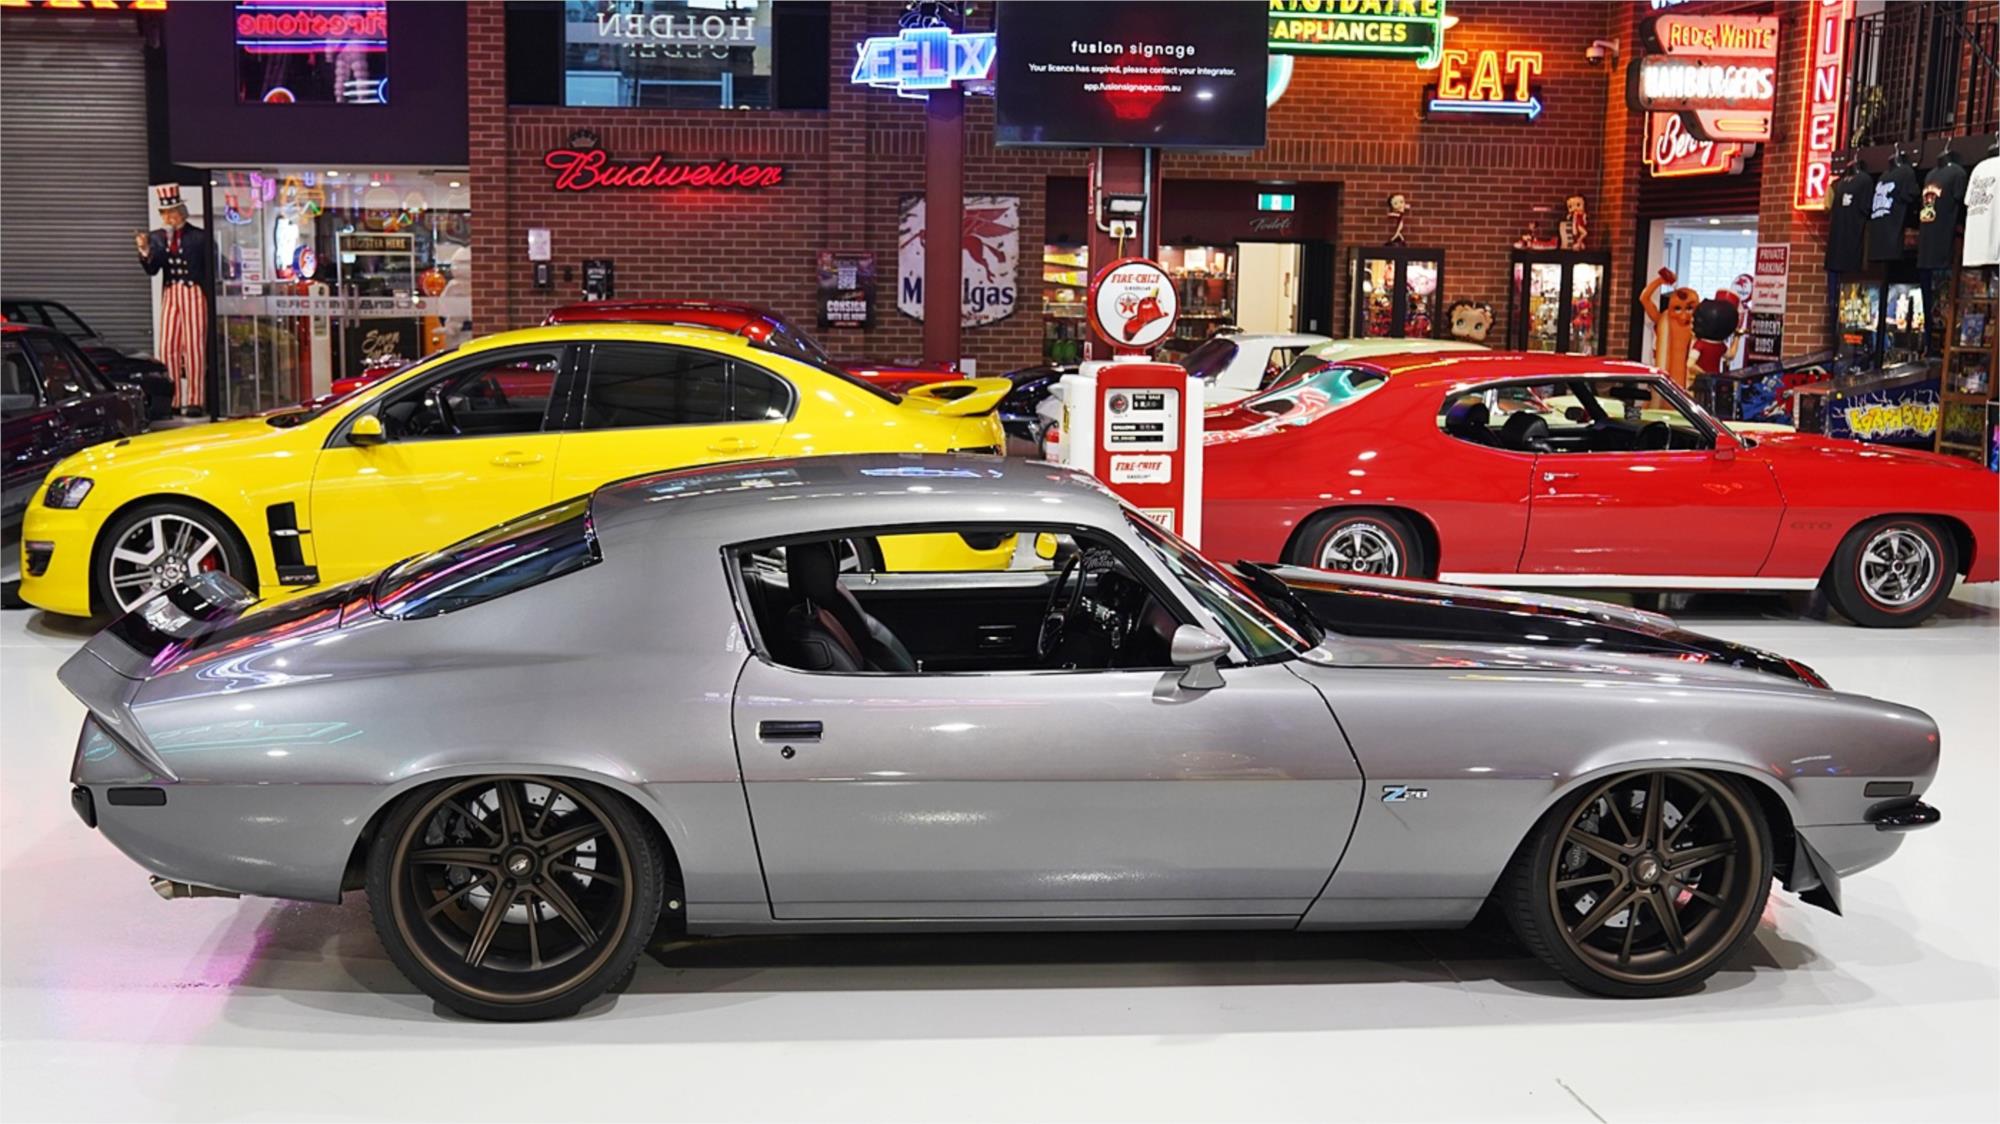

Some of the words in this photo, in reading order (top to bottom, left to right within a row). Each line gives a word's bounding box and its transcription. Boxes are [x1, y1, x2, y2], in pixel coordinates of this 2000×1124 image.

[1274, 20, 1407, 42] APPLIANCES
[1669, 23, 1701, 46] RED
[1716, 23, 1774, 49] WHITE
[869, 39, 985, 77] FELIX
[1071, 40, 1124, 54] fusion
[1129, 42, 1196, 58] signage
[1028, 63, 1047, 72] Your
[1048, 63, 1075, 73] licence
[1076, 64, 1090, 73] has
[1091, 65, 1121, 75] expired,
[1122, 66, 1148, 75] please
[1149, 67, 1178, 75] contact
[1178, 68, 1197, 76] your
[1197, 66, 1236, 76] integrator.
[1438, 49, 1543, 101] EAT
[1083, 83, 1181, 92] app.fusionsignage.com.au
[1644, 65, 1774, 100] HAMBURGERS
[1805, 0, 1837, 198] INER
[545, 150, 783, 190] Budweiser
[1759, 247, 1785, 260] PRIVATE
[1757, 261, 1784, 274] PARKING
[903, 277, 1014, 312] Mlgas
[827, 300, 867, 312] CONSIGN
[1751, 319, 1781, 335] CURRENT
[1790, 521, 1833, 529] GTO
